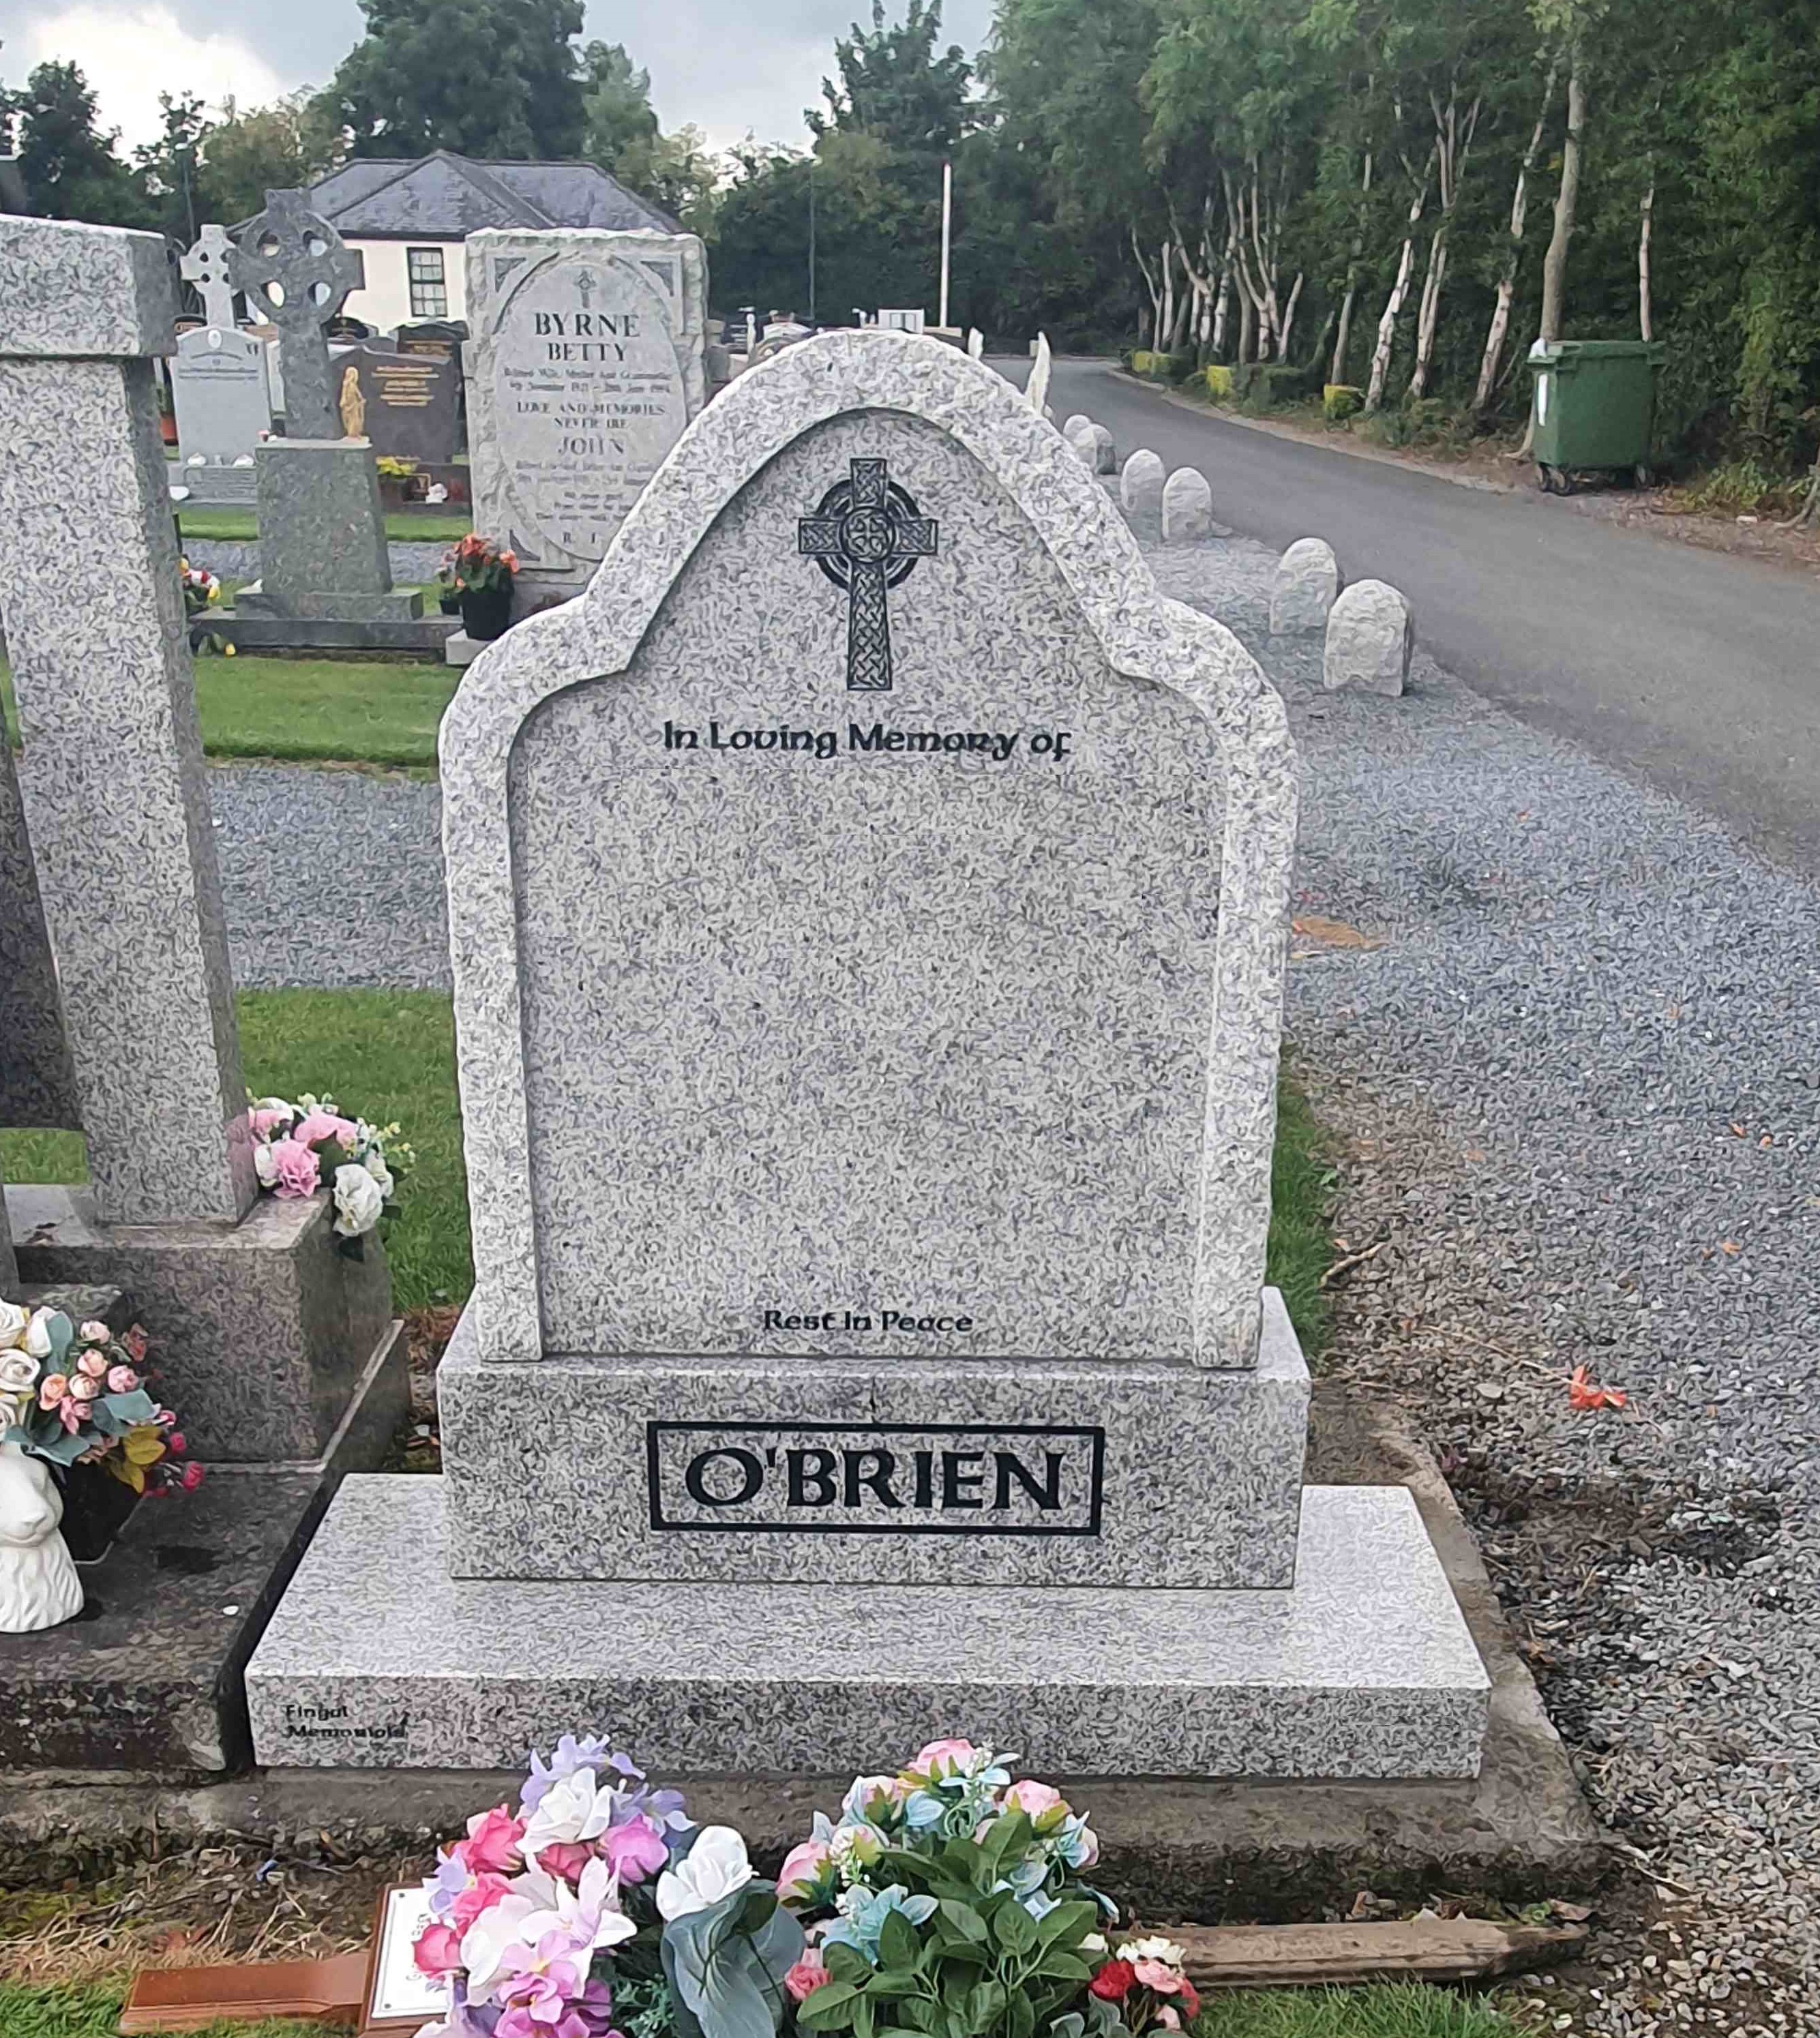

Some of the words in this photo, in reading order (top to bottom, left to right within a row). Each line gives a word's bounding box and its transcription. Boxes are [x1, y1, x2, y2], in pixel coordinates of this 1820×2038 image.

[535, 312, 640, 337] BYRNE
[548, 342, 627, 361] BETTY
[517, 401, 550, 414] LOVE
[559, 402, 586, 413] AND
[591, 403, 666, 415] MEMORIES
[554, 417, 598, 428] NEVER
[558, 436, 625, 455] JOHN
[663, 721, 698, 749] In
[710, 721, 838, 759] Loving
[849, 723, 1019, 761] Memory
[1030, 732, 1072, 762] of
[764, 1310, 839, 1330] Rest
[844, 1311, 872, 1330] In
[882, 1310, 973, 1330] Peace
[685, 1446, 1063, 1510] O'BRIEN
[286, 1705, 348, 1721] Fingal
